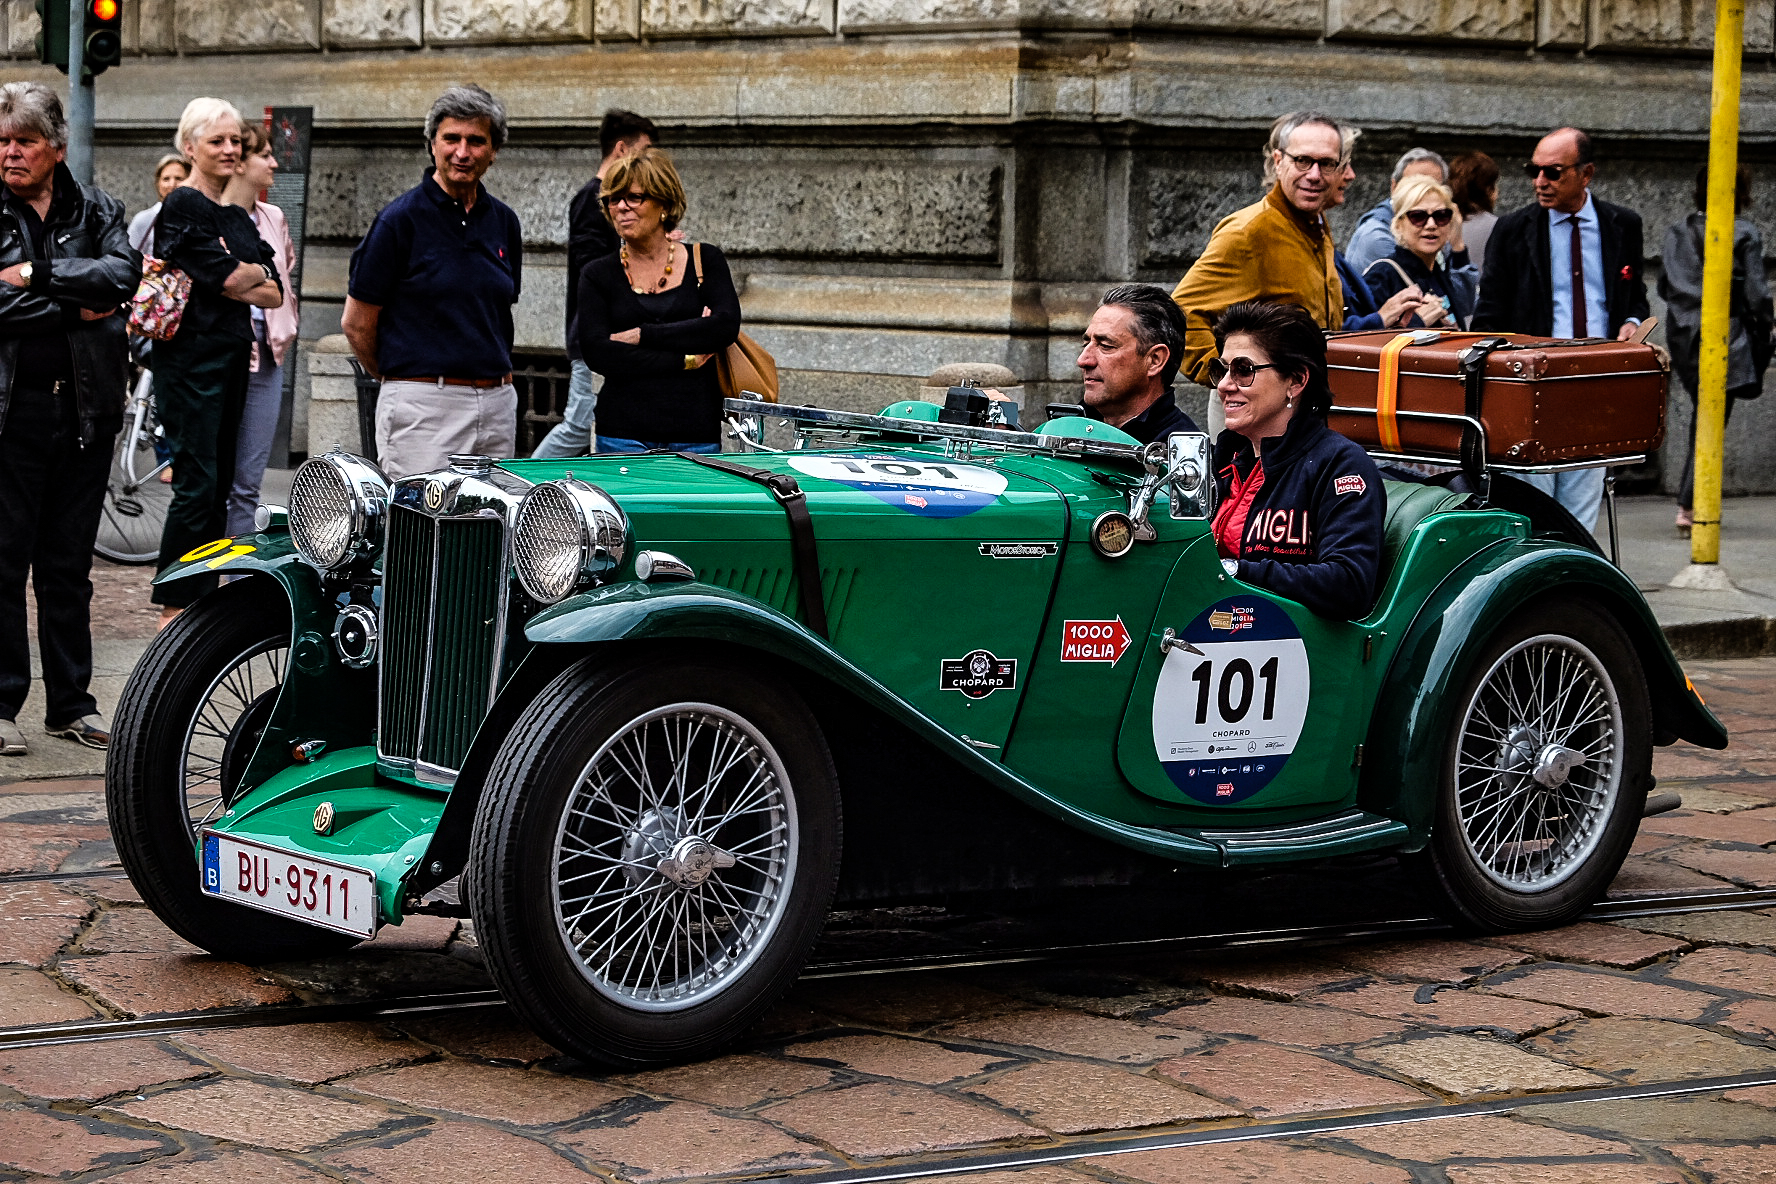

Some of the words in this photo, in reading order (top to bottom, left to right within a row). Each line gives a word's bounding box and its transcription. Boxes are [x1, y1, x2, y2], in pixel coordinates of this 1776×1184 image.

[830, 461, 959, 480] 101
[426, 482, 440, 507] MG
[1337, 483, 1361, 493] MIGLIA
[1246, 508, 1312, 545] MIGLI
[1273, 546, 1307, 555] Beautiful
[1070, 625, 1113, 639] 1000
[1065, 643, 1115, 658] MIGLIA
[952, 678, 1004, 687] CHOPARD
[1191, 656, 1279, 724] 101
[1212, 729, 1251, 738] CHOPARD
[315, 805, 330, 829] MG
[207, 867, 218, 887] B
[237, 850, 349, 920] BU-9311
